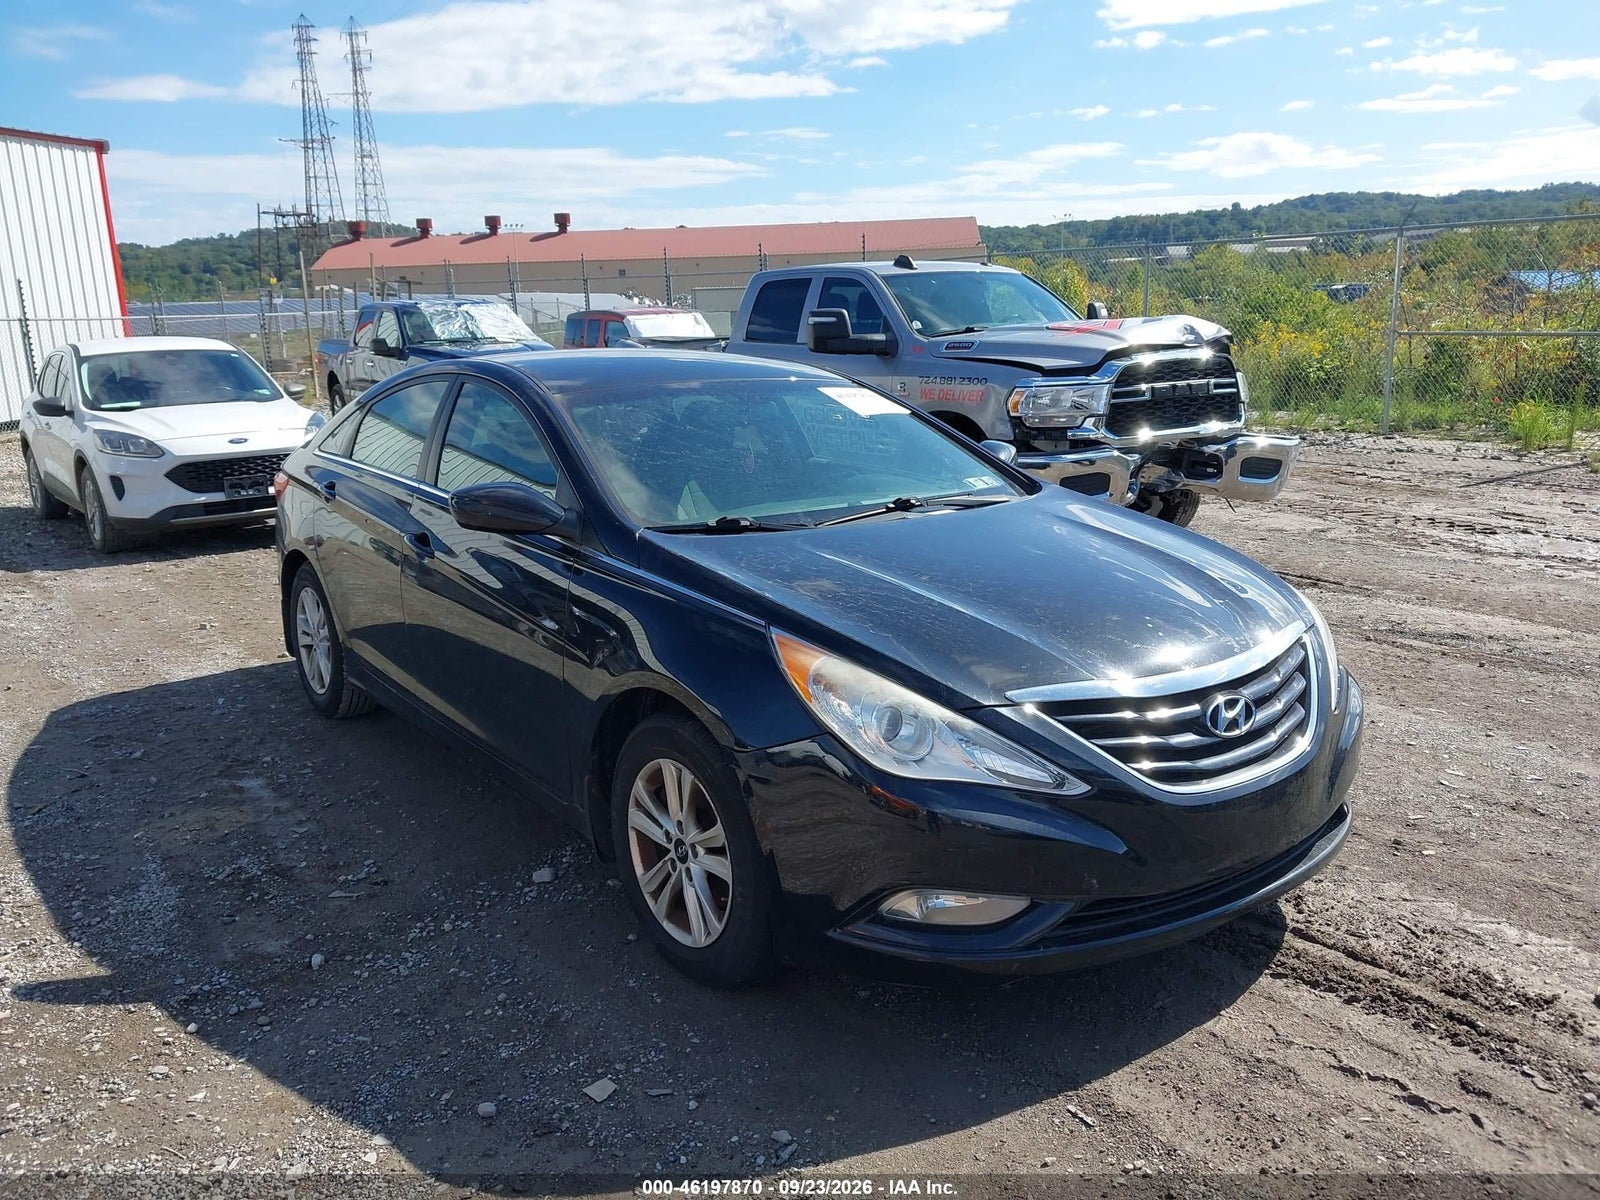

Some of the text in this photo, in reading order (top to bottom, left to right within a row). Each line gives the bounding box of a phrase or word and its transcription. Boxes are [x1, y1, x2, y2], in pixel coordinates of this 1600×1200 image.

[918, 375, 988, 386] 724.881.2300
[919, 387, 985, 402] WE DELIVER
